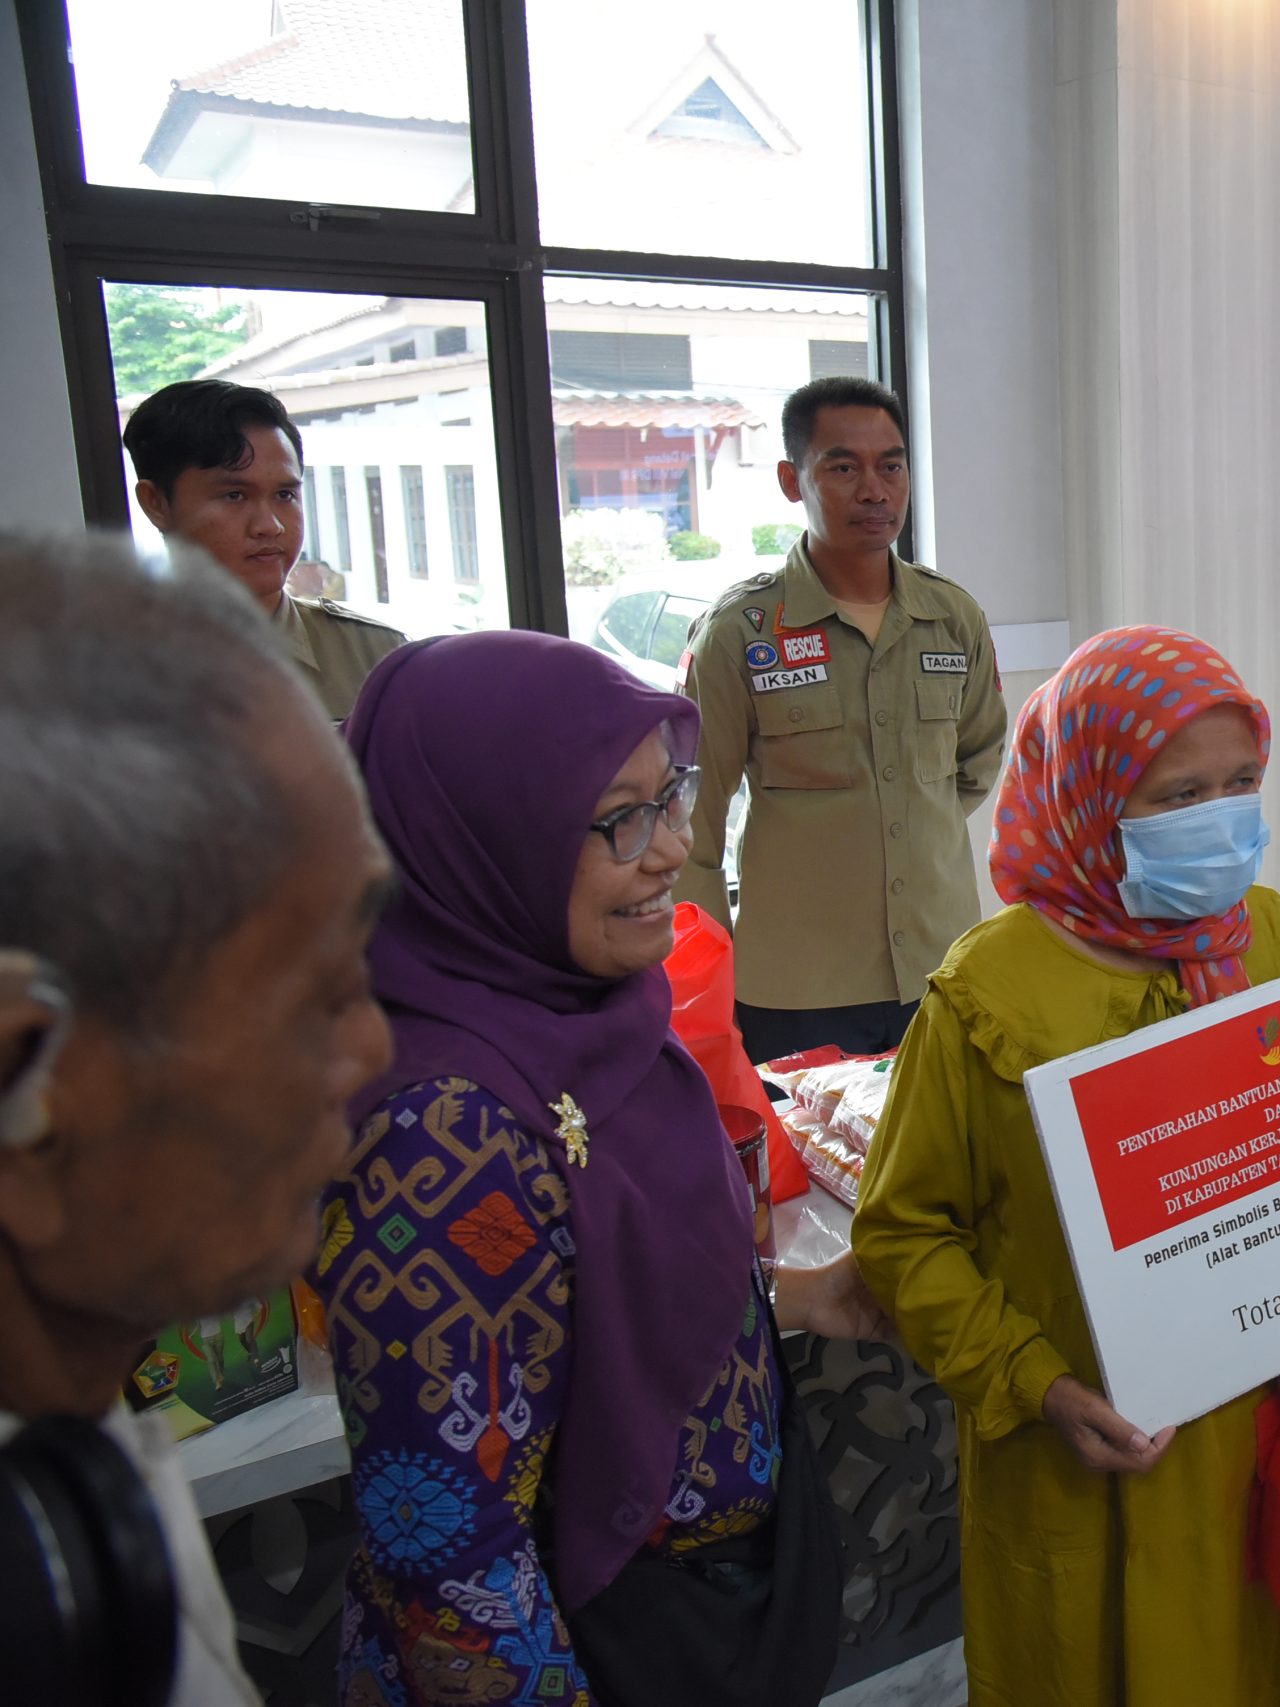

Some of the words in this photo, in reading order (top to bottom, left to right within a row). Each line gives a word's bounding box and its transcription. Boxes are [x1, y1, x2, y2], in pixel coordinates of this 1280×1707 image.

[783, 633, 825, 662] RESCUE
[926, 656, 967, 669] TAGAN
[761, 668, 818, 689] IKSAN
[1117, 1104, 1218, 1156] PENYERAHAN
[1158, 1143, 1248, 1192] KUNJUNGAN
[1165, 1195, 1183, 1215] DI
[1182, 1159, 1267, 1208] KABUPATEN
[1144, 1230, 1210, 1269] Penerima
[1212, 1204, 1270, 1239] Simbolis
[1205, 1242, 1240, 1269] (Alat
